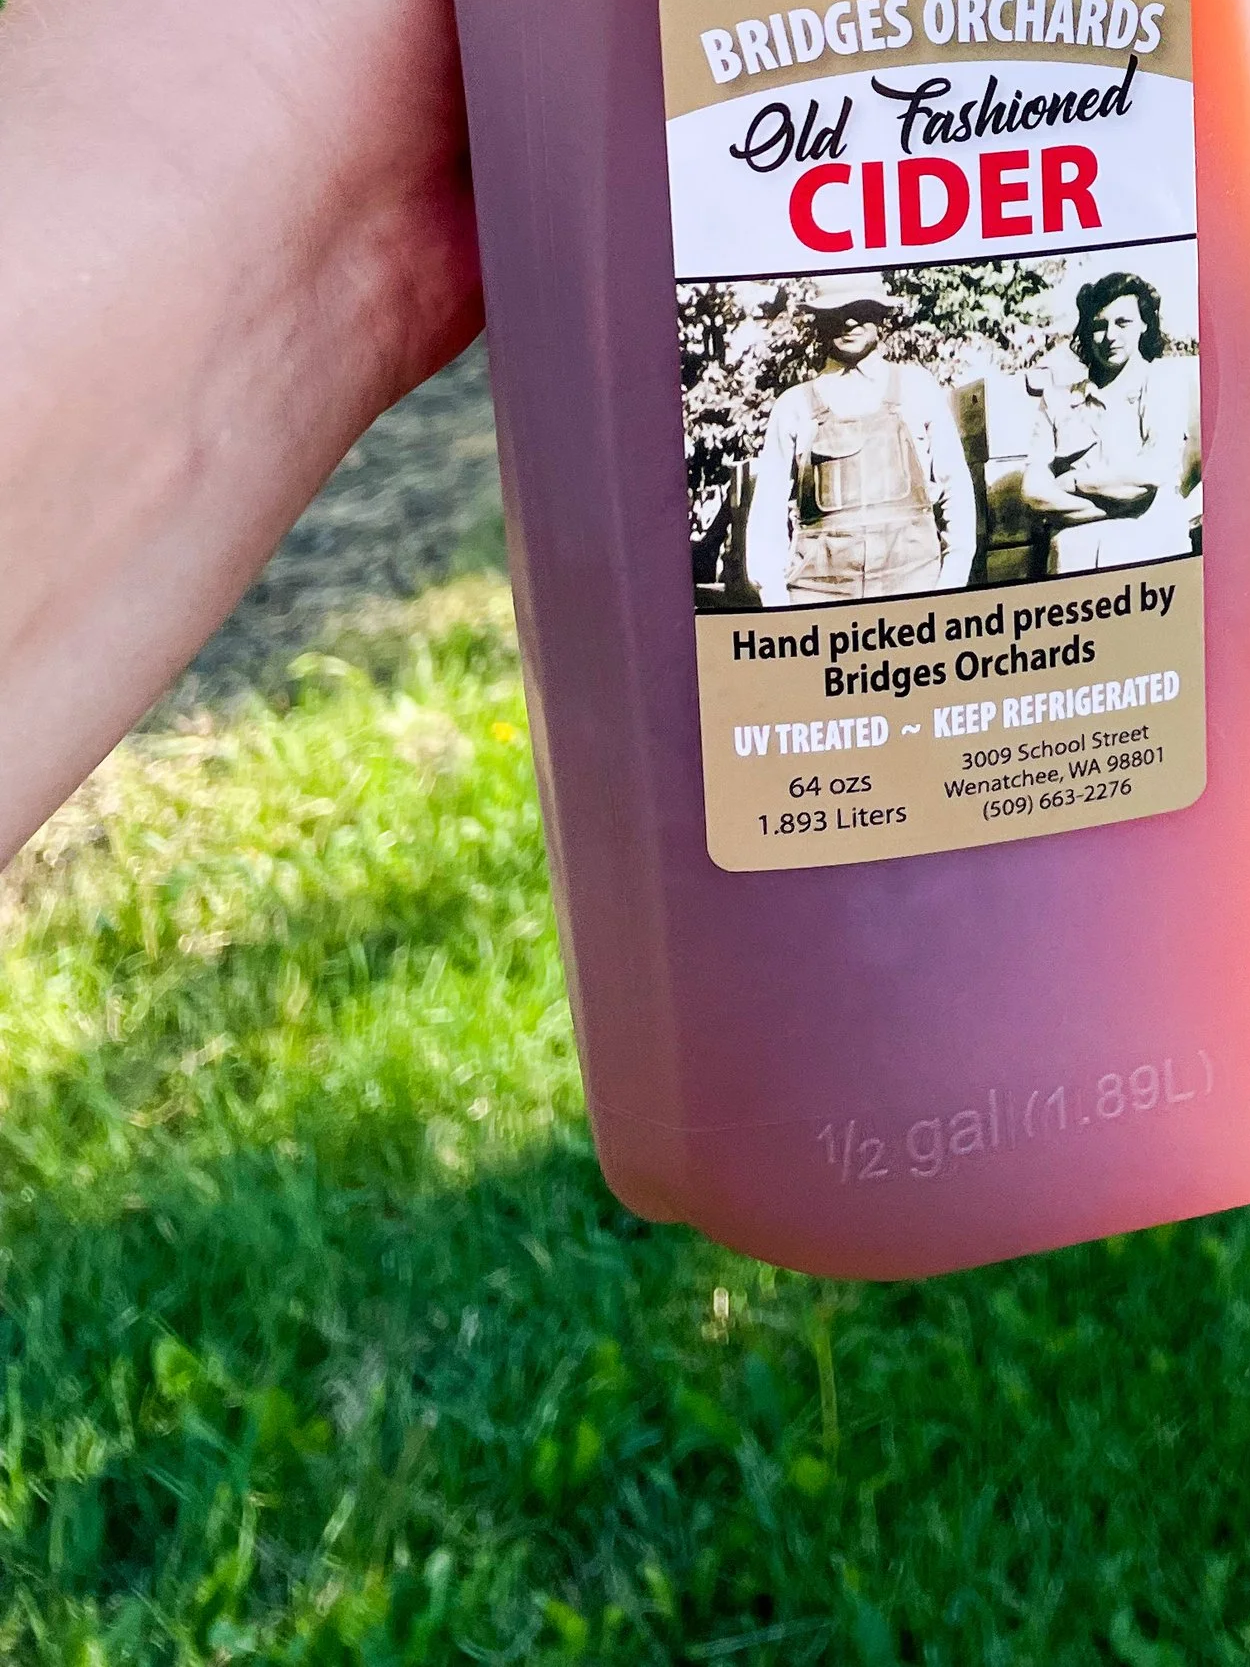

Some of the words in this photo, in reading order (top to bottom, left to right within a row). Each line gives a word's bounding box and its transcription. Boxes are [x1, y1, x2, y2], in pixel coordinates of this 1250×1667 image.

[729, 96, 853, 173] Old
[871, 54, 1138, 154] Fashioned
[789, 144, 1102, 253] CIDER
[732, 626, 819, 661] Hand
[829, 613, 936, 662] picked
[945, 603, 1004, 641] and
[1014, 589, 1131, 639] pressed
[1140, 582, 1176, 616] by
[824, 659, 946, 698] Bridges
[955, 636, 1096, 681] Orchards
[733, 725, 771, 757] UV
[775, 716, 889, 754] TREATED
[934, 701, 996, 738] KEEP
[1002, 670, 1180, 728] REFRIGERATED
[944, 764, 1063, 798] Wenatchee,
[1069, 759, 1101, 778] WA
[1107, 747, 1164, 771] 98801
[961, 746, 1012, 770] 3009
[1018, 734, 1085, 761] School
[1092, 725, 1149, 749] Street
[789, 776, 821, 798] 64
[830, 774, 872, 795] ozs
[982, 795, 1033, 821] (509)
[1039, 778, 1132, 809] 663-2276
[759, 811, 827, 836] 1.893
[837, 804, 907, 830] Liters
[907, 1088, 998, 1178] gal
[1024, 1050, 1214, 1138] (1.89L)
